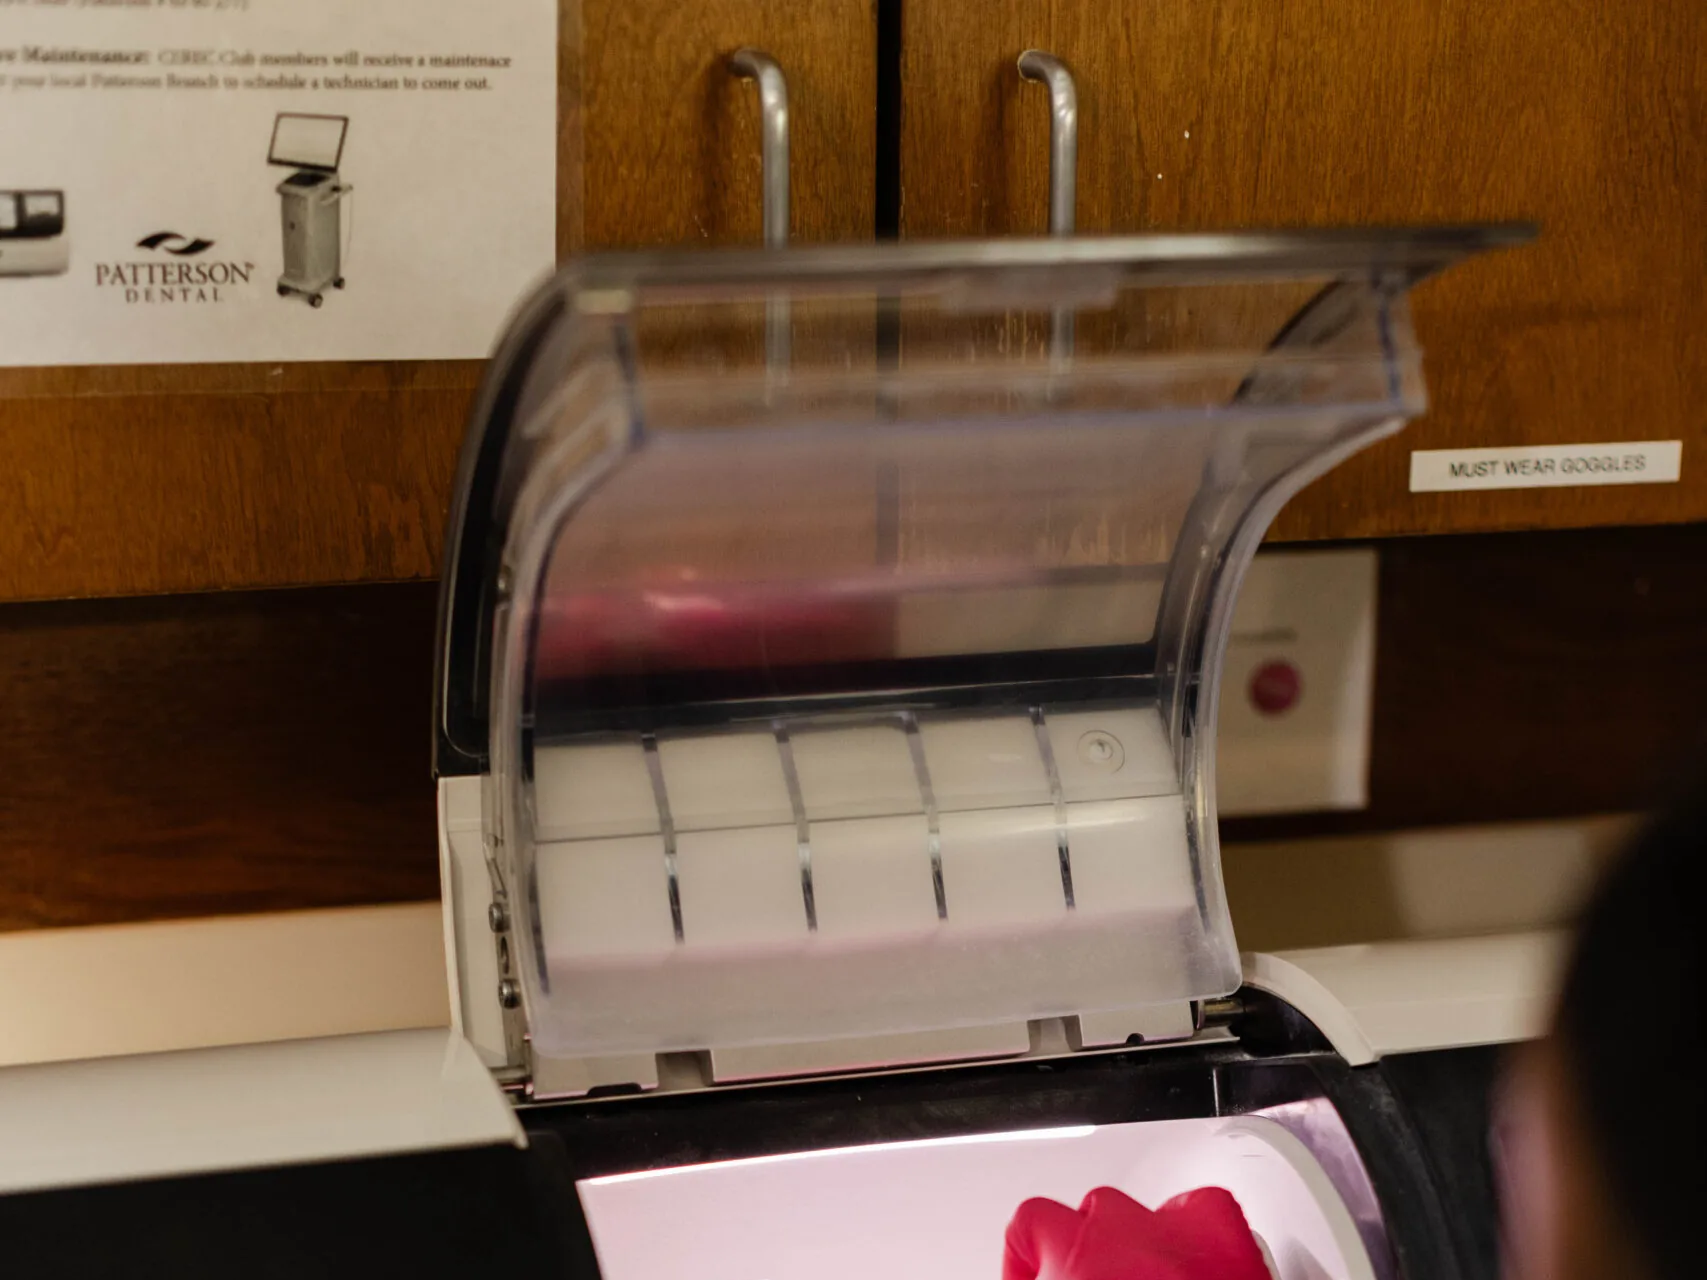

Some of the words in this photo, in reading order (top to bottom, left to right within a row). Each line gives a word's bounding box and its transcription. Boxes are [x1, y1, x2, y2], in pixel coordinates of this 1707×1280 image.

[260, 51, 328, 67] members
[333, 51, 359, 67] will
[363, 53, 413, 68] receive
[323, 74, 398, 90] technician
[403, 76, 417, 90] to
[422, 78, 459, 90] come
[464, 77, 492, 91] out.
[125, 287, 223, 303] DENTAL
[1450, 460, 1498, 478] MUST
[1504, 457, 1555, 477] WEAR
[1561, 454, 1646, 474] GOGGLES
